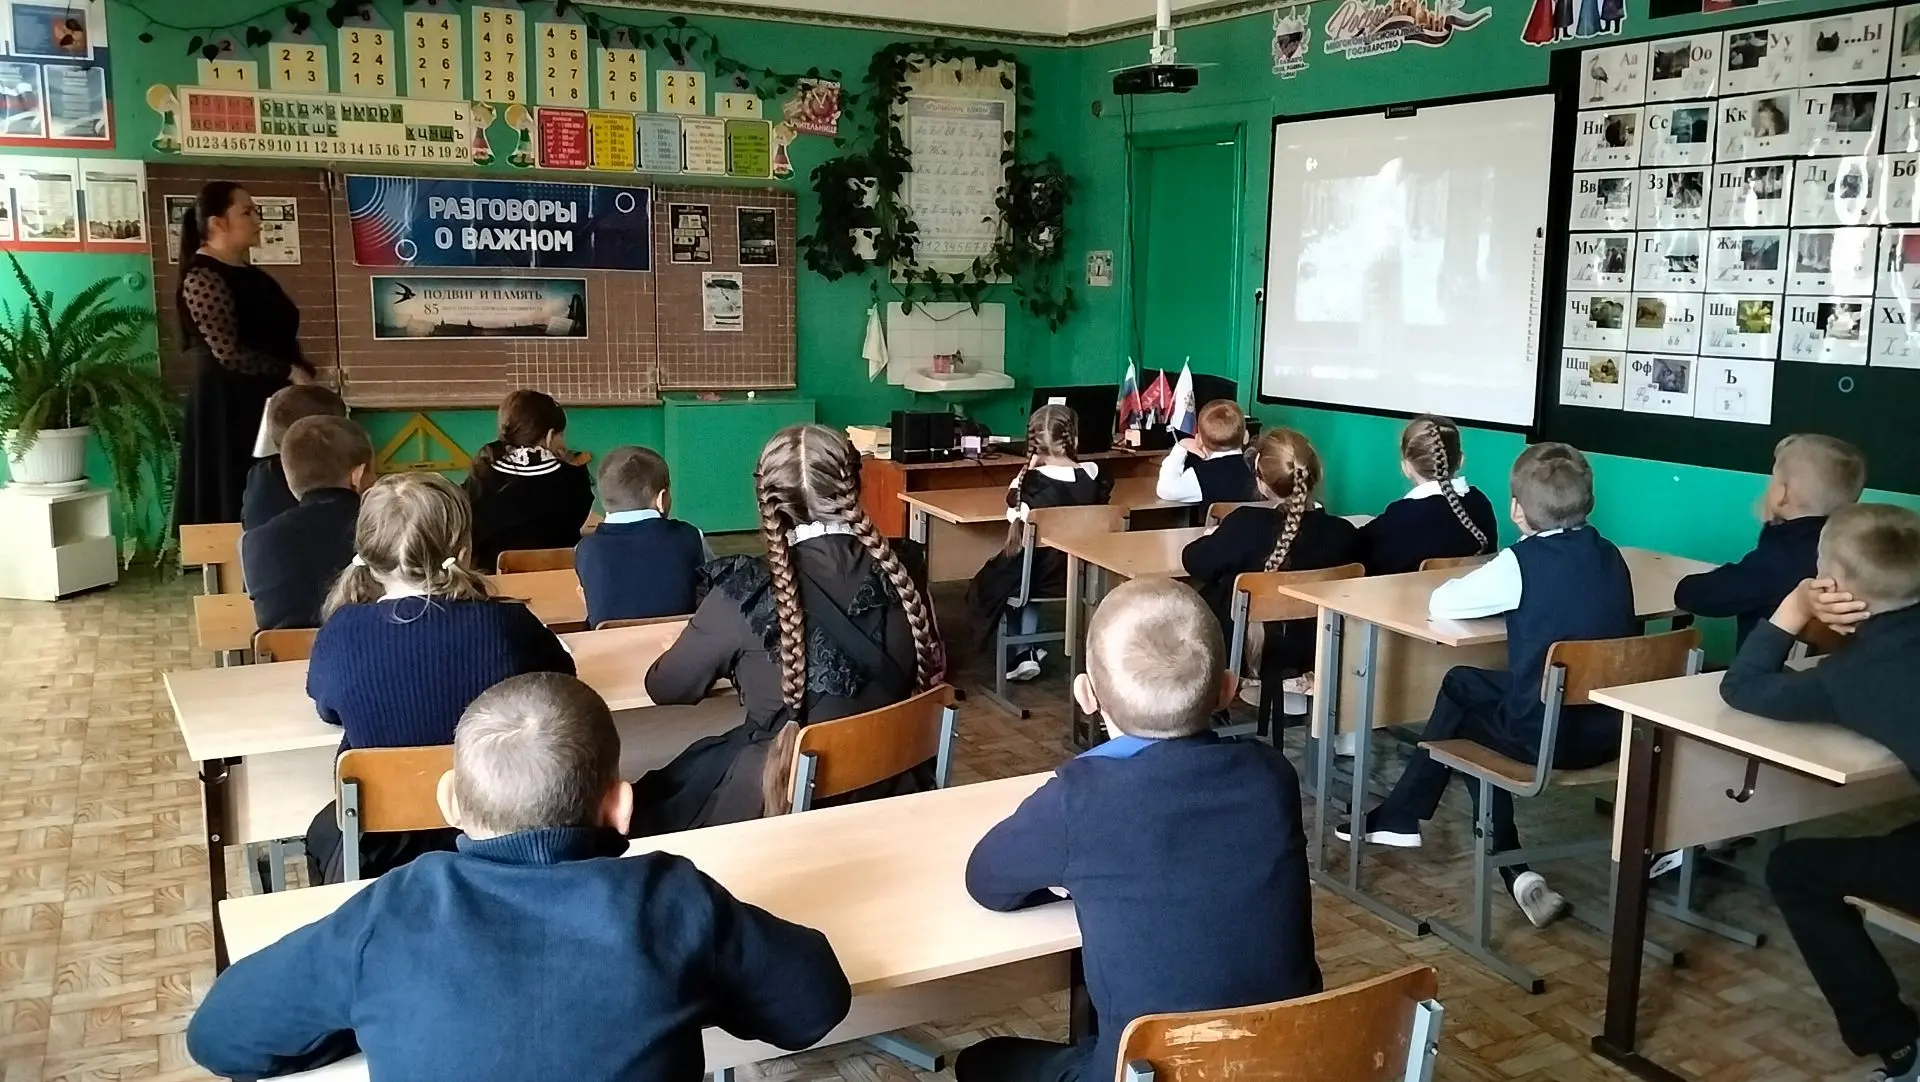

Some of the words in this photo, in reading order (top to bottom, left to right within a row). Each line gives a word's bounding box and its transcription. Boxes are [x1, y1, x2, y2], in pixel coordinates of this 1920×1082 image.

[417, 18, 424, 28] 4
[442, 20, 448, 30] 4
[484, 13, 491, 23] 5
[506, 14, 512, 25] 5
[352, 32, 359, 43] 3
[375, 34, 382, 45] 3
[484, 32, 491, 43] 4
[506, 34, 513, 44] 6
[547, 28, 554, 38] 4
[570, 30, 577, 40] 5
[222, 41, 231, 51] 2
[418, 38, 425, 48] 3
[442, 38, 449, 49] 5
[1770, 33, 1794, 52] Уу
[283, 50, 290, 60] 2
[307, 51, 314, 61] 2
[352, 53, 360, 63] 2
[376, 55, 383, 65] 4
[484, 52, 491, 62] 3
[507, 53, 514, 64] 7
[548, 48, 555, 58] 3
[570, 50, 577, 60] 6
[609, 52, 616, 62] 3
[629, 54, 636, 64] 4
[1692, 46, 1712, 62] Оо
[419, 58, 426, 69] 2
[443, 59, 449, 69] 6
[213, 68, 219, 78] 1
[237, 69, 243, 79] 1
[284, 70, 290, 80] 1
[308, 71, 315, 81] 3
[354, 73, 360, 84] 1
[377, 75, 384, 85] 5
[485, 71, 492, 81] 2
[507, 72, 514, 82] 8
[548, 68, 555, 78] 2
[571, 69, 577, 79] 7
[609, 71, 616, 81] 2
[630, 72, 637, 82] 5
[421, 78, 426, 88] 1
[443, 79, 450, 89] 7
[668, 76, 675, 86] 2
[689, 77, 695, 87] 3
[486, 89, 492, 99] 1
[508, 90, 515, 100] 9
[550, 87, 555, 97] 1
[571, 88, 578, 99] 8
[610, 91, 616, 100] 1
[630, 92, 637, 102] 6
[669, 94, 675, 104] 1
[689, 95, 696, 105] 4
[726, 99, 731, 108] 1
[747, 100, 753, 110] 2
[1805, 99, 1827, 115] Тт
[1726, 108, 1747, 123] Кк
[1583, 121, 1603, 135] Нн
[1650, 115, 1668, 130] Сс
[296, 140, 308, 152] 11
[315, 141, 328, 153] 12
[332, 142, 346, 155] 13
[351, 143, 364, 155] 14
[369, 144, 382, 155] 15
[387, 144, 400, 156] 16
[405, 145, 416, 157] 17
[422, 146, 434, 158] 18
[439, 146, 451, 158] 19
[456, 146, 468, 159] 20
[1893, 160, 1917, 177] Бб
[1580, 180, 1596, 193] Вв
[1648, 174, 1664, 190] Зз
[1720, 173, 1742, 188] Пп
[429, 197, 577, 223] РАЗГОВОРЫ
[435, 227, 453, 249] О
[462, 227, 573, 252] ВАЖНОМ
[424, 290, 473, 300] ПОДВИГ
[481, 290, 488, 299] И
[493, 290, 543, 300] ПАМЯТЬ
[424, 304, 439, 315] 85
[1571, 301, 1588, 314] Чч
[1792, 307, 1816, 325] Цц
[1881, 307, 1905, 324] Хх
[1632, 360, 1652, 376] Фф
[1725, 370, 1737, 384] Ъ
